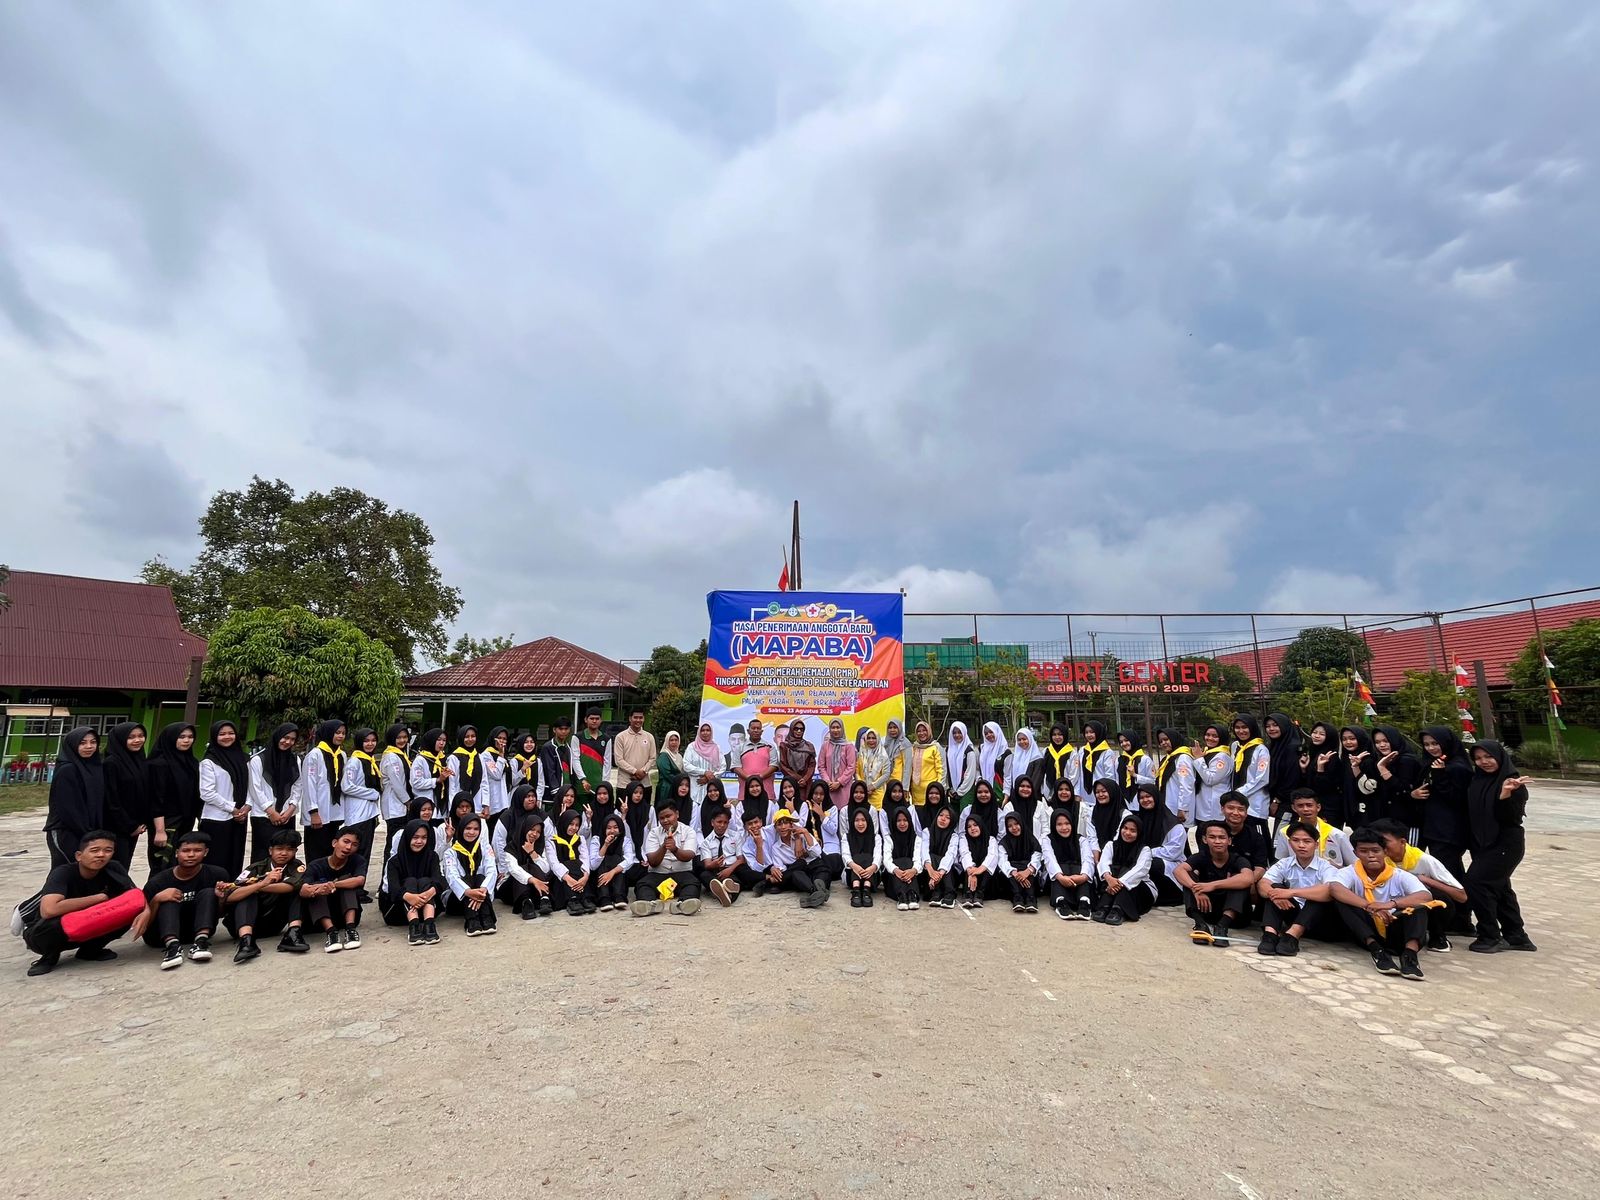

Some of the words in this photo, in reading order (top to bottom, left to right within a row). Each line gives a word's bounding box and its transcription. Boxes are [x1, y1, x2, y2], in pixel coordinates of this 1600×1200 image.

[733, 621, 756, 632] MASA
[757, 622, 809, 633] PENERIMAAN
[811, 623, 849, 634] ANGGOTA
[850, 624, 872, 634] BARU
[731, 634, 874, 663] (MAPABA)
[746, 667, 775, 676] PALANG
[776, 667, 801, 676] MERAH
[802, 667, 831, 677] REMAJA
[1027, 661, 1104, 683] SPORT
[1119, 661, 1210, 683] CENTER
[715, 677, 745, 686] TINGKAT
[747, 677, 765, 686] WIRA
[766, 677, 782, 686] MAN
[788, 678, 813, 687] BUNGO
[814, 678, 833, 687] PLUS
[834, 679, 889, 688] KETERAMPILAN
[1078, 684, 1101, 692] MAN
[1119, 684, 1157, 692] BUNGO
[1163, 684, 1190, 692] 2019
